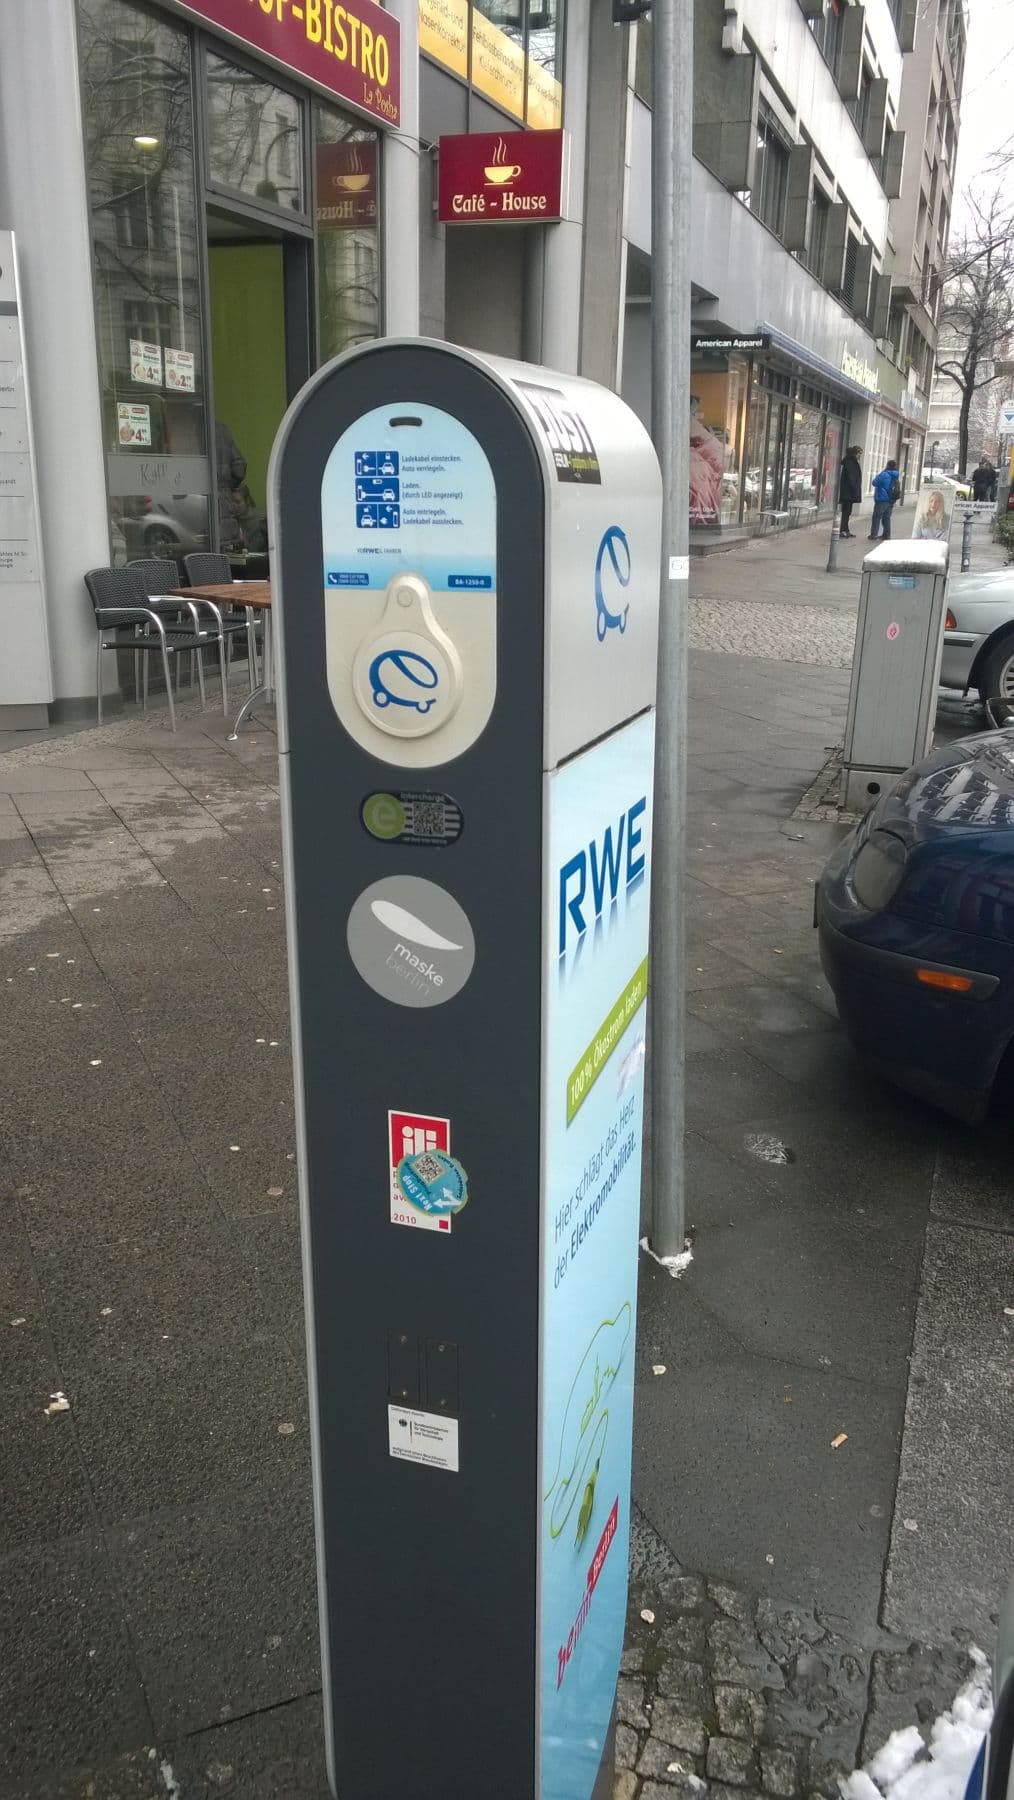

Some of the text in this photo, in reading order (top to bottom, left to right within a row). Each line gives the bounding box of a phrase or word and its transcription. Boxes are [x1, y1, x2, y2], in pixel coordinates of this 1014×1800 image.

[250, 0, 389, 86] -BISTRO
[452, 194, 486, 213] Café
[502, 192, 547, 211] House
[696, 338, 763, 348] American Apparel
[402, 491, 420, 499] (durch
[432, 517, 464, 525] ausstecken.
[558, 796, 647, 956] RWE
[385, 951, 432, 998] berlin
[393, 943, 443, 986] maske
[571, 1069, 585, 1106] 100
[593, 1008, 625, 1068] Ökostrom
[625, 981, 642, 1016] laden
[555, 1096, 636, 1244] Hier schlägt das Herz
[393, 1213, 417, 1224] 2010
[554, 1130, 637, 1290] der Elektromobilität.
